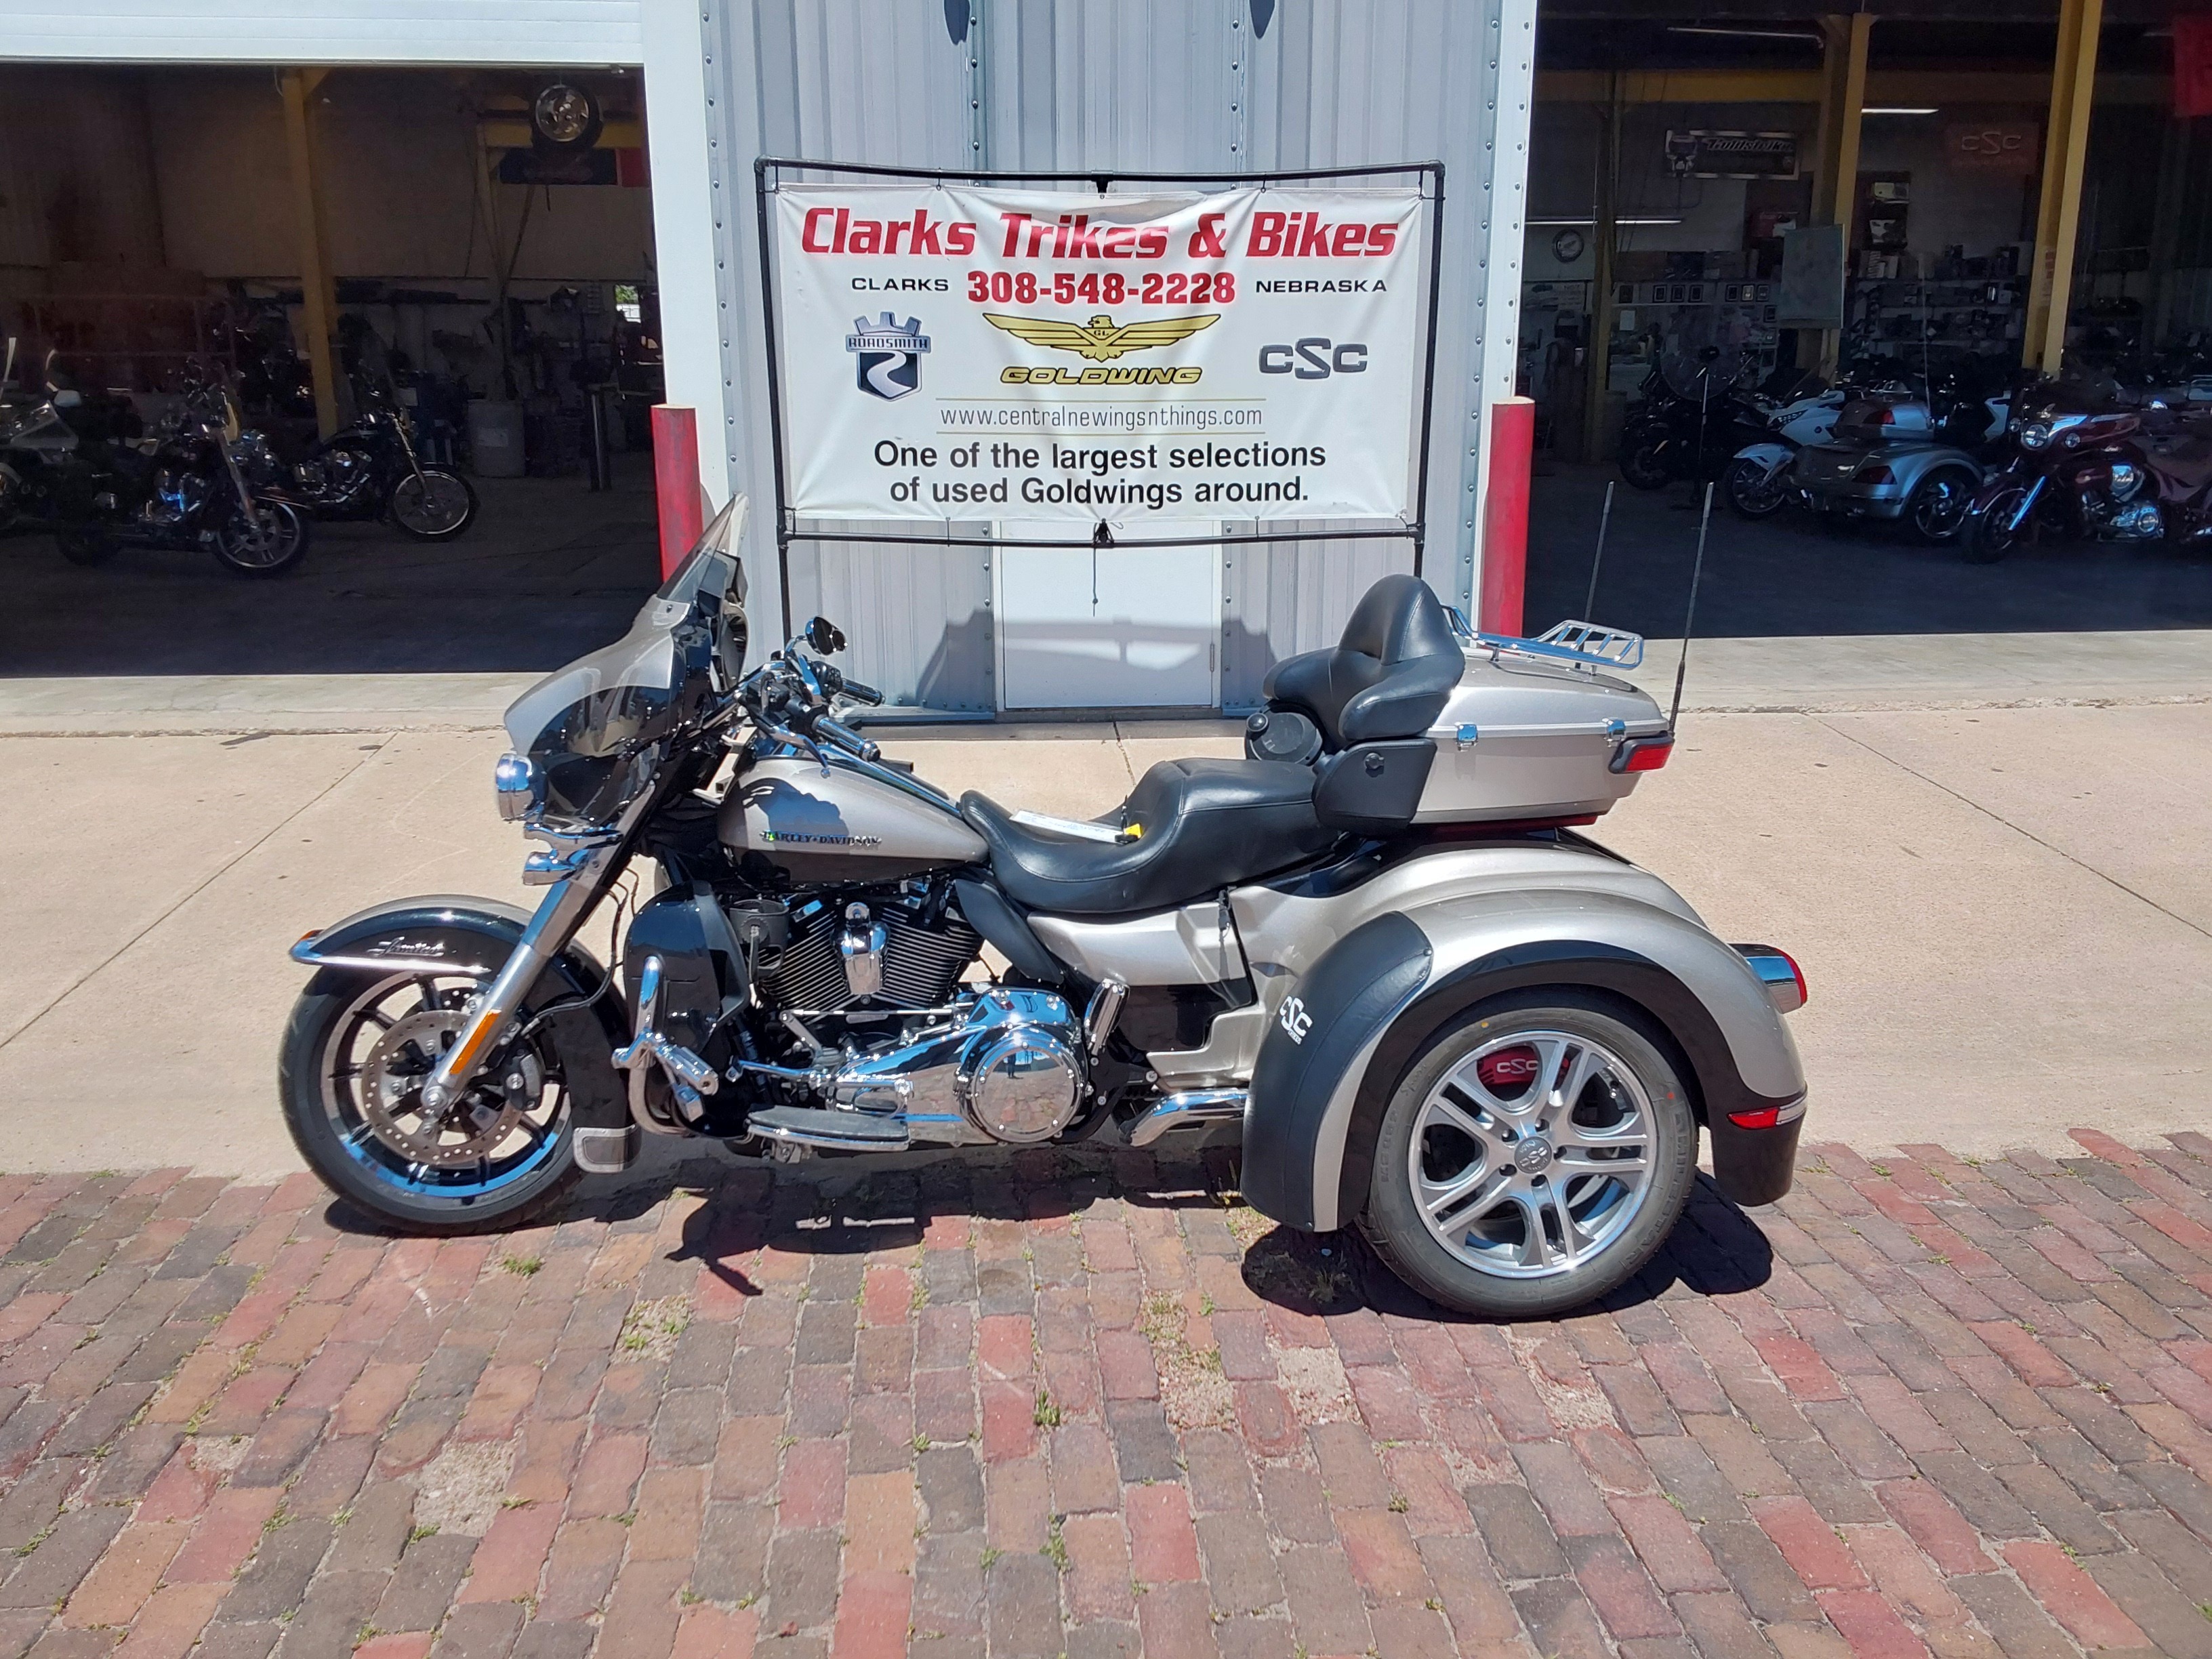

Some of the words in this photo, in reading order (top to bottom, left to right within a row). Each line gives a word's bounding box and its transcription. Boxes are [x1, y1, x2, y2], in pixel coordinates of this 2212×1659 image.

[801, 207, 977, 255] Clarks
[1000, 213, 1168, 259] Trikes
[1188, 213, 1226, 258] &
[1246, 211, 1399, 258] Bikes
[852, 277, 949, 291] CLARKS
[967, 270, 1235, 304] 308-548-2228
[1256, 279, 1388, 293] NEBRASKA
[848, 337, 928, 348] ROADSMITH
[1000, 367, 1203, 385] GOLDWING
[941, 406, 1263, 430] www.centralnewingsnthings.com
[874, 440, 937, 466] One
[949, 442, 980, 468] of
[990, 442, 1040, 468] the
[1052, 443, 1158, 476] largest
[1168, 441, 1326, 468] selections
[890, 476, 920, 501] of
[933, 477, 1008, 503] used
[1021, 477, 1183, 510] Goldwings
[1194, 476, 1308, 502] around.
